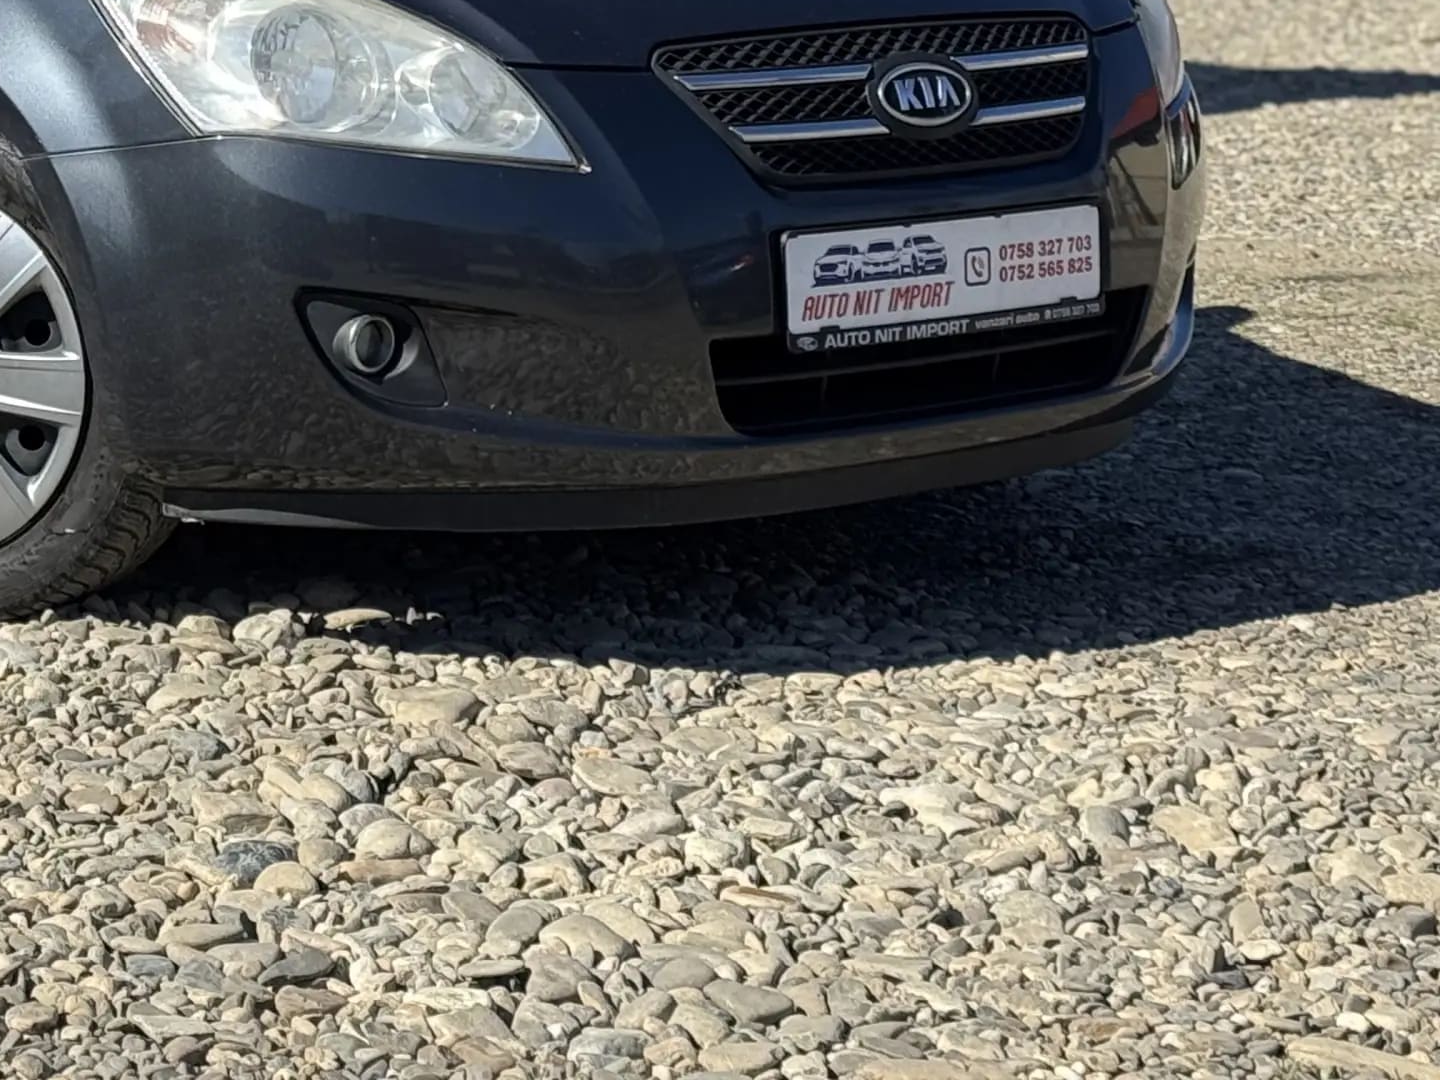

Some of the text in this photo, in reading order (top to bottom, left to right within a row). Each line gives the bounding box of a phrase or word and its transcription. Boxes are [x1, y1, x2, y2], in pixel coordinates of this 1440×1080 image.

[892, 74, 961, 111] KIA
[999, 234, 1093, 261] 0758 327 703
[999, 256, 1093, 282] 0752 565 825
[801, 281, 956, 322] AUTO NIT IMPORT
[824, 332, 872, 349] AUTO
[875, 327, 903, 343] NIT
[906, 319, 970, 340] IMPORT
